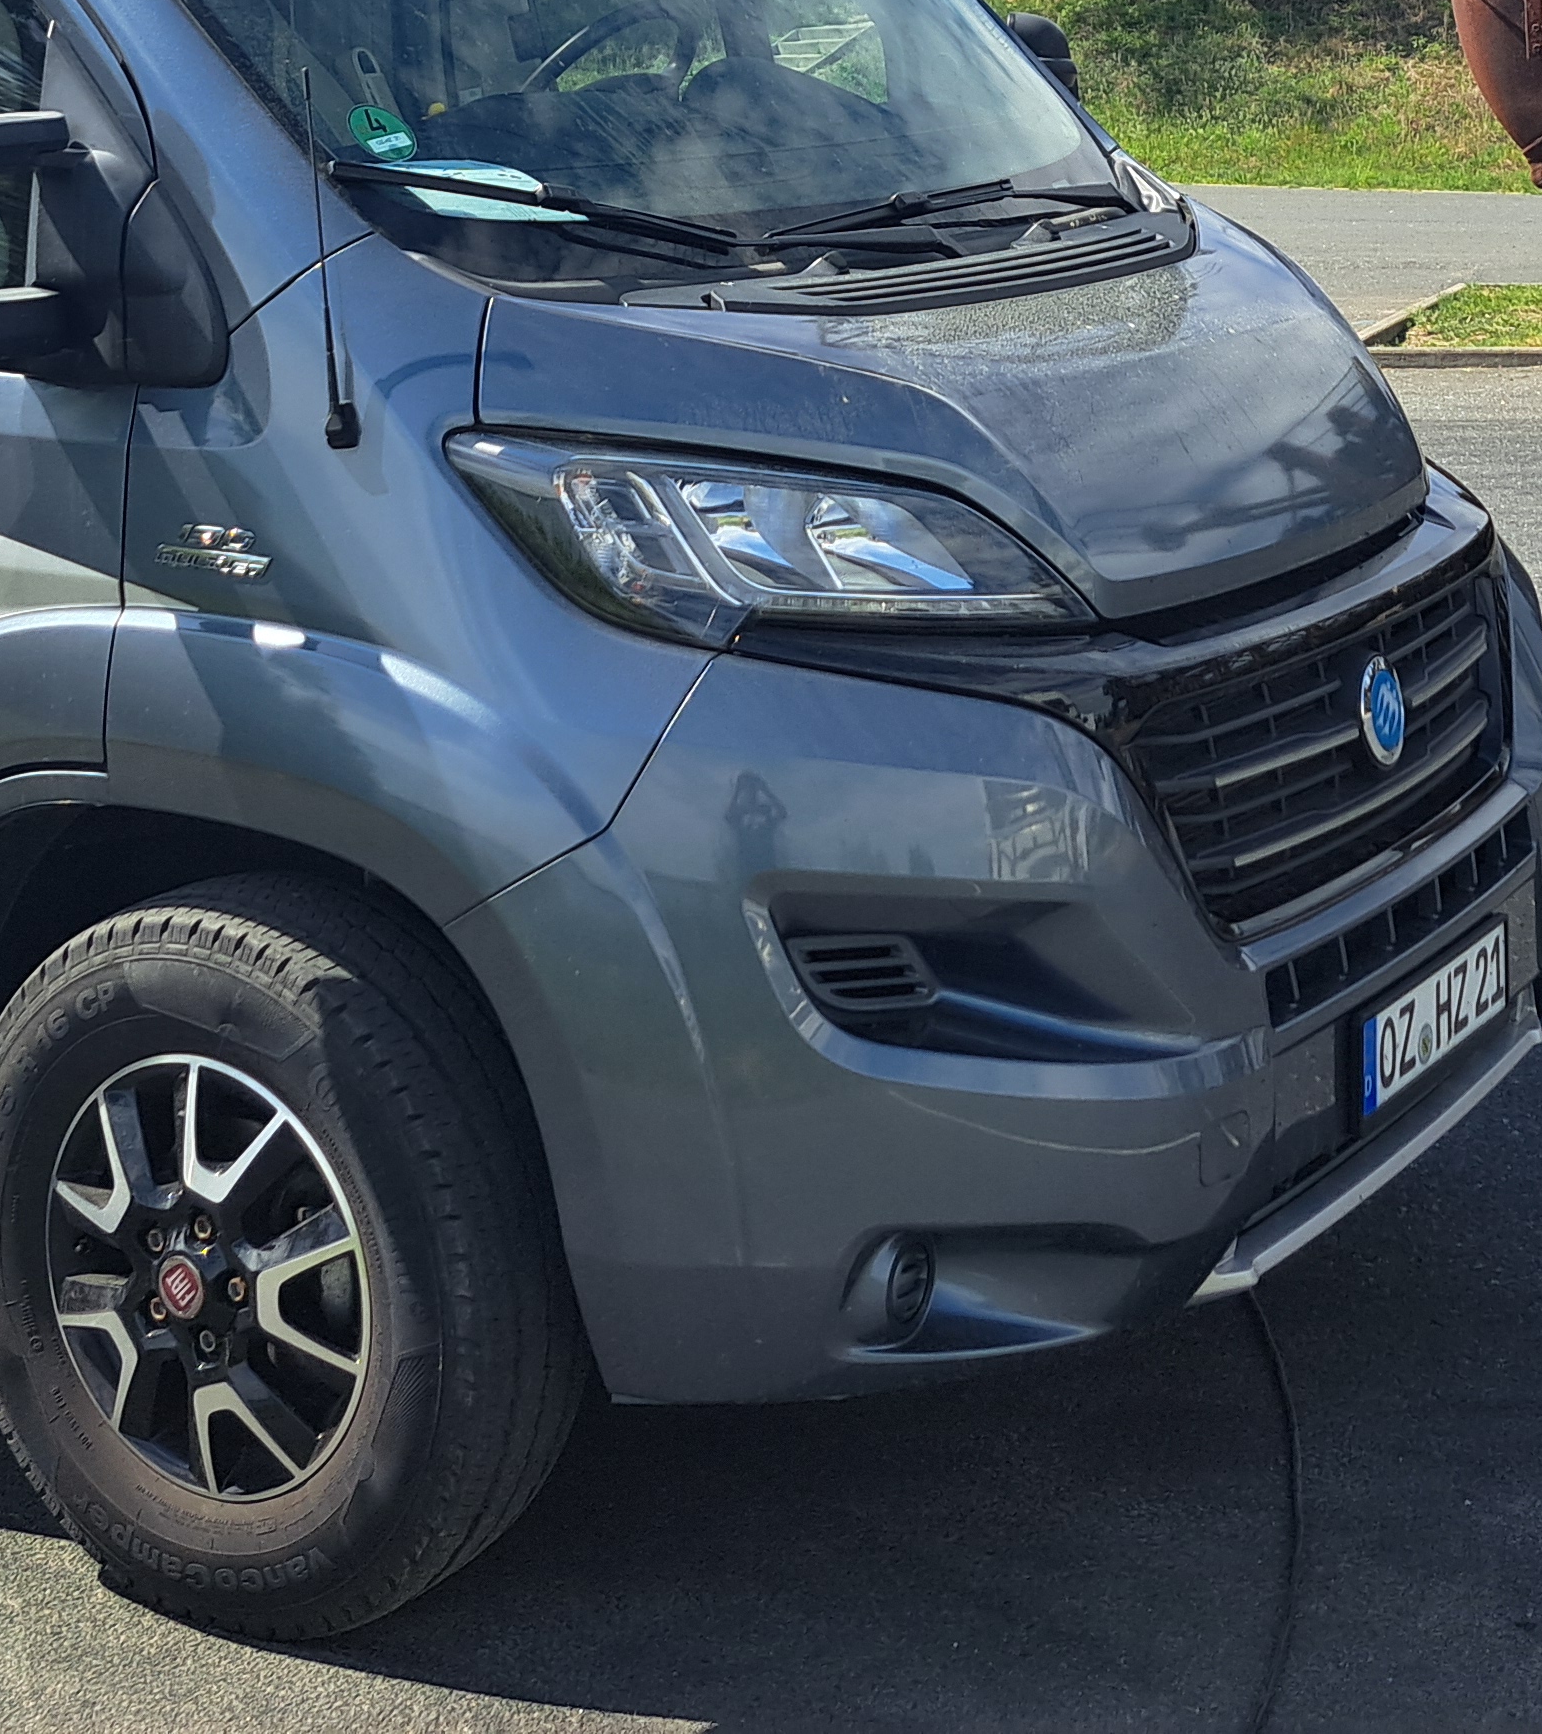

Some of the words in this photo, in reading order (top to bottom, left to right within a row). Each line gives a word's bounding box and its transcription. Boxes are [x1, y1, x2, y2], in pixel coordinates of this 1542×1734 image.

[363, 108, 388, 134] 4
[75, 980, 115, 1021] CP
[1379, 997, 1417, 1089] OZ
[1435, 958, 1469, 1051] HZ
[1475, 934, 1504, 1020] 21
[1364, 1074, 1373, 1097] D
[165, 1267, 197, 1307] FIAT
